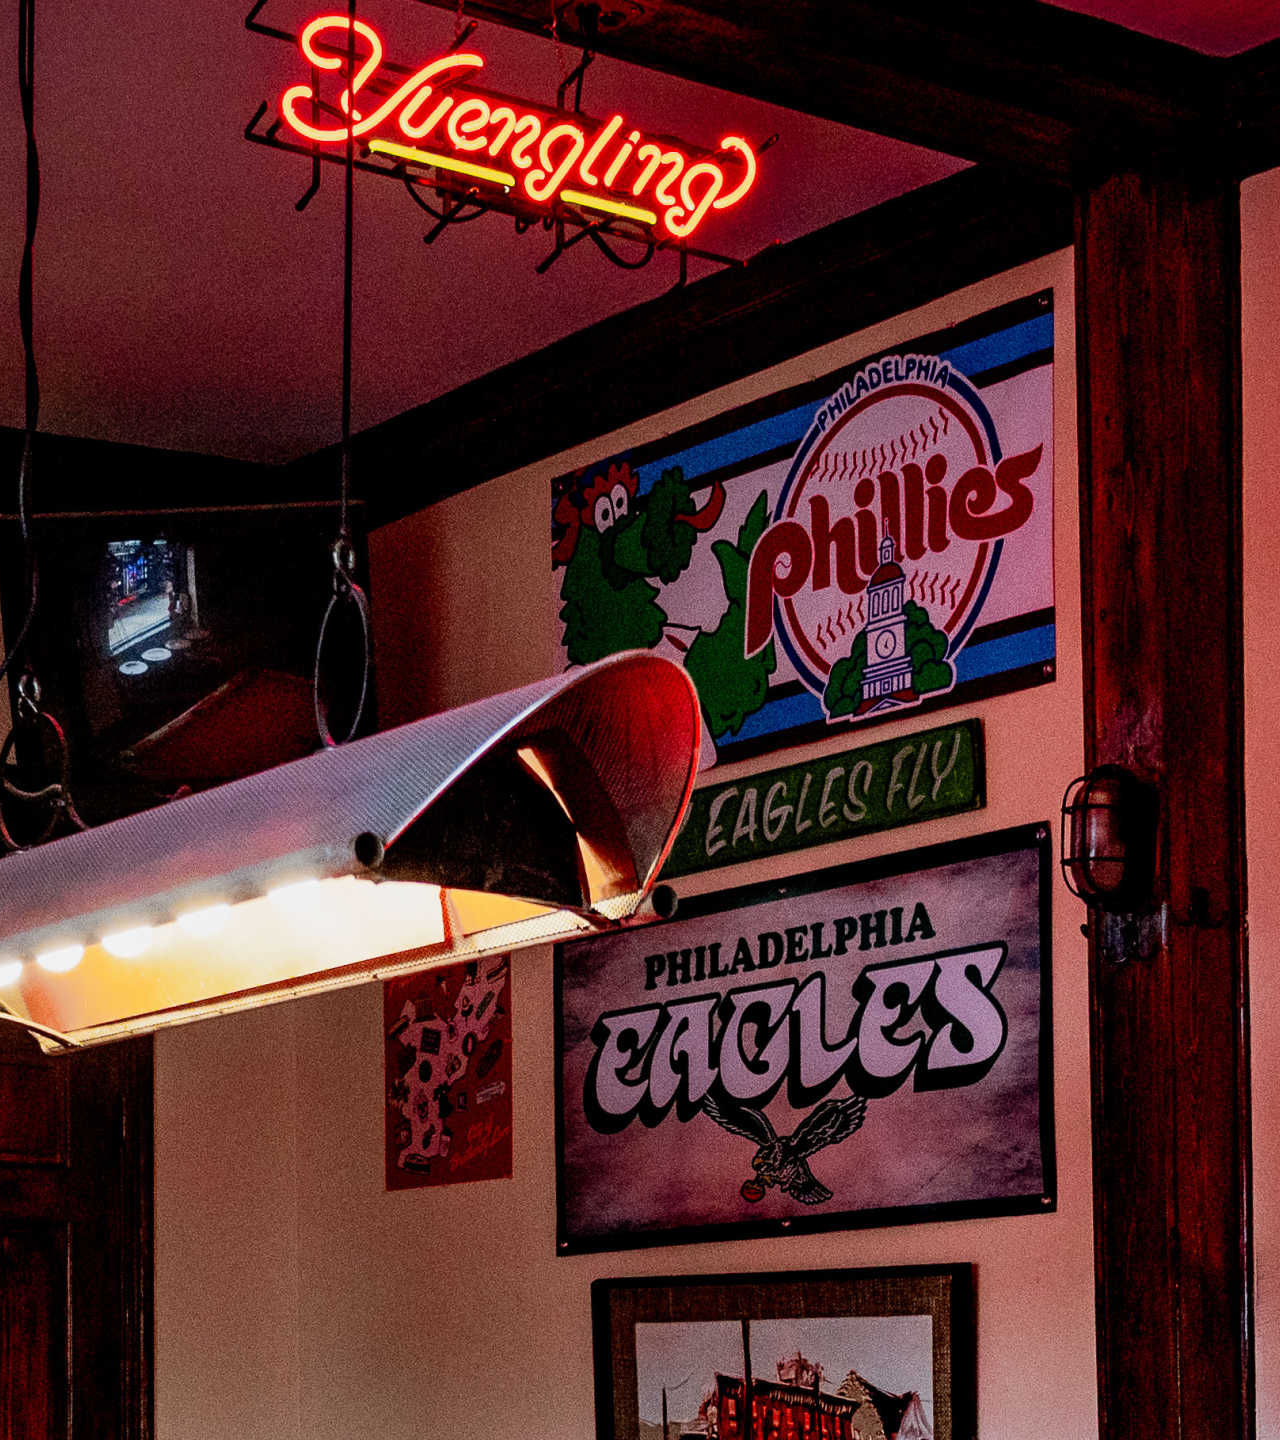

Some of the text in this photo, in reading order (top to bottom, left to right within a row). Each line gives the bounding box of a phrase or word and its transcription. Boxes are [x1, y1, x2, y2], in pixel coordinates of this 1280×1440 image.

[281, 15, 757, 237] Yuengling
[817, 354, 951, 432] PHILADELPHIA
[706, 732, 962, 857] EAGLES FLY
[644, 902, 936, 990] PHILADELPHIA
[585, 942, 1008, 1132] EAGLES
